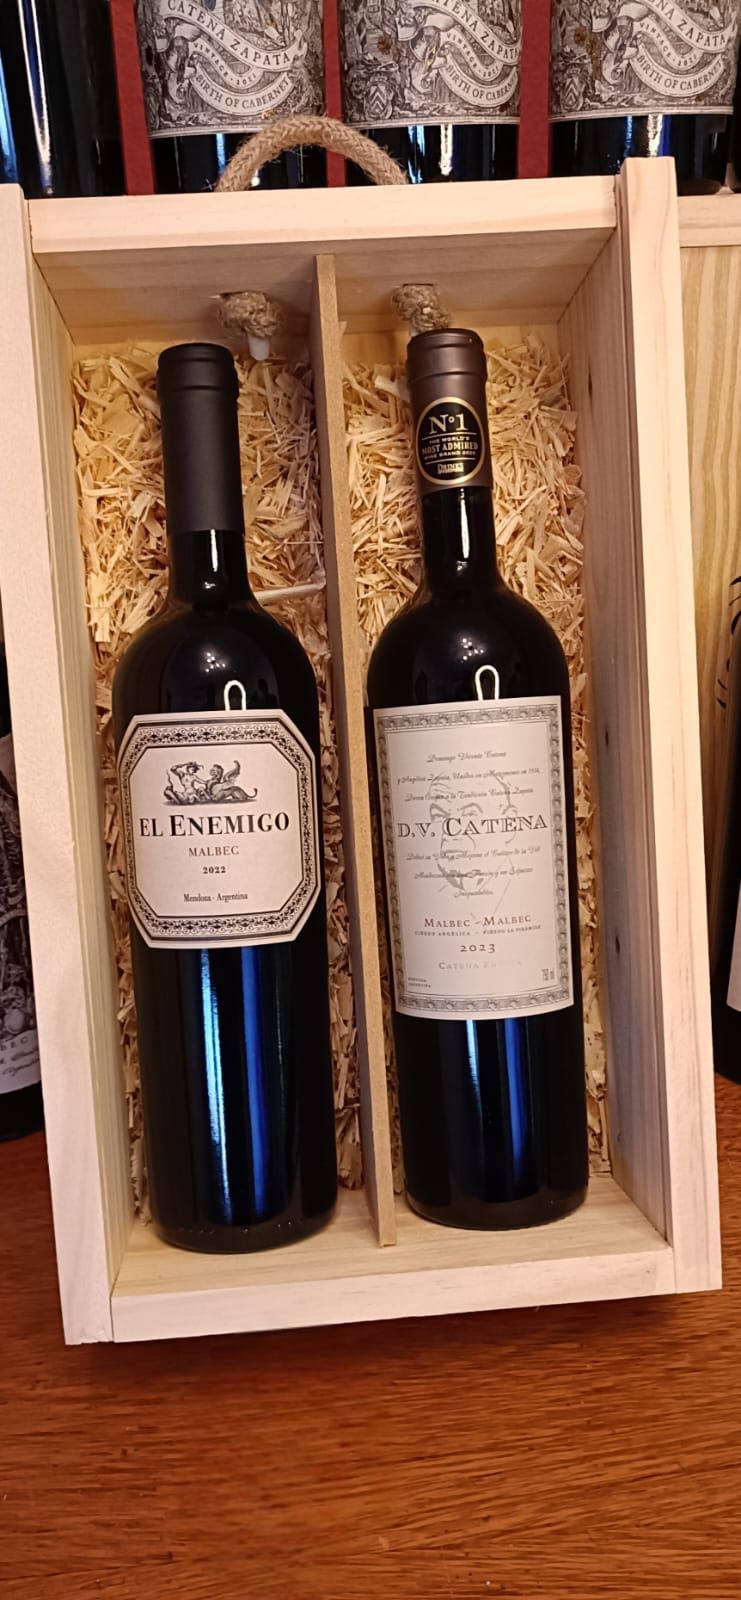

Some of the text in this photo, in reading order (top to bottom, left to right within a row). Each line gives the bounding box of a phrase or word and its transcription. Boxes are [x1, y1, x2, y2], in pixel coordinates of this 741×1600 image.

[168, 0, 290, 66] CATENA ZAPATA
[676, 18, 726, 47] ZAPATA
[445, 64, 471, 94] BIRTH
[472, 89, 485, 99] OF
[636, 54, 663, 83] BIRTH
[663, 78, 679, 89] OF
[196, 74, 290, 110] BIRTH OF CABERNET
[421, 441, 478, 455] MOST ADMIRED
[139, 812, 290, 837] EL ENEMIGO
[397, 814, 548, 838] D.V. CATENA
[188, 846, 240, 857] MALBEC
[202, 866, 226, 875] 2022
[183, 893, 212, 903] Mendoza
[217, 892, 248, 903] Argentina
[424, 917, 471, 928] MALBEC
[483, 914, 532, 927] MALBEC
[459, 943, 497, 954] 2023
